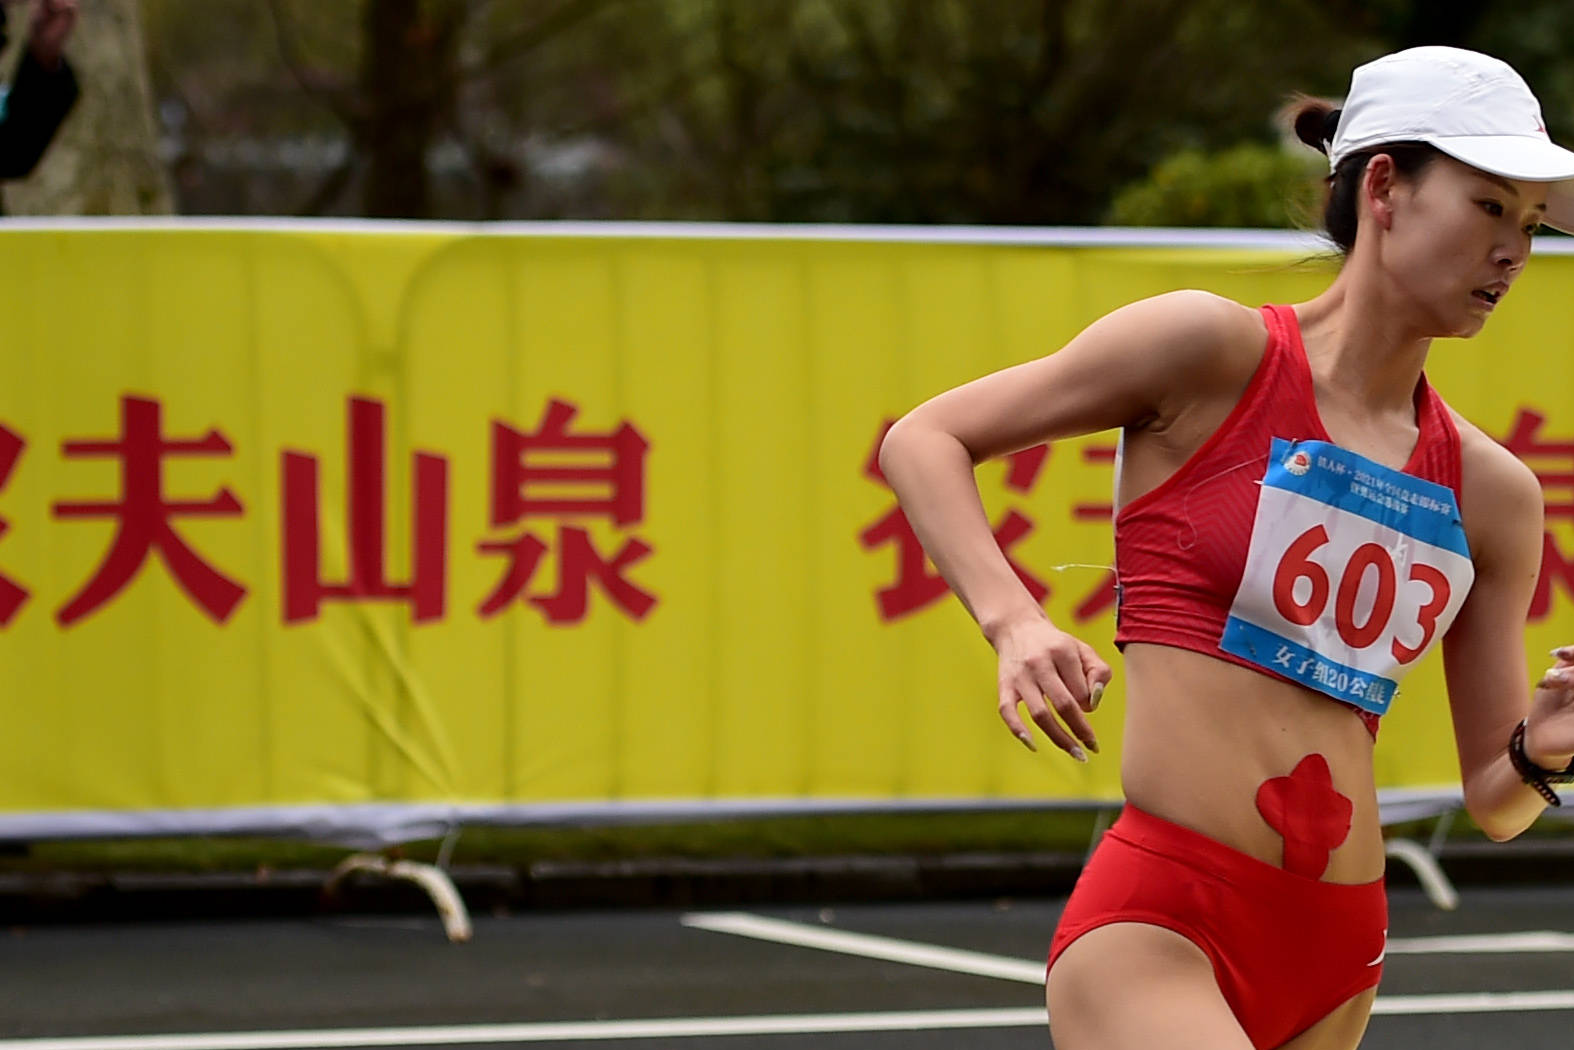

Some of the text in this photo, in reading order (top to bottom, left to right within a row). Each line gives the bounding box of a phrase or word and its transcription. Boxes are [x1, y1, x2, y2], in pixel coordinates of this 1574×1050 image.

[0, 394, 661, 632] 夫山泉
[1273, 524, 1451, 665] 603
